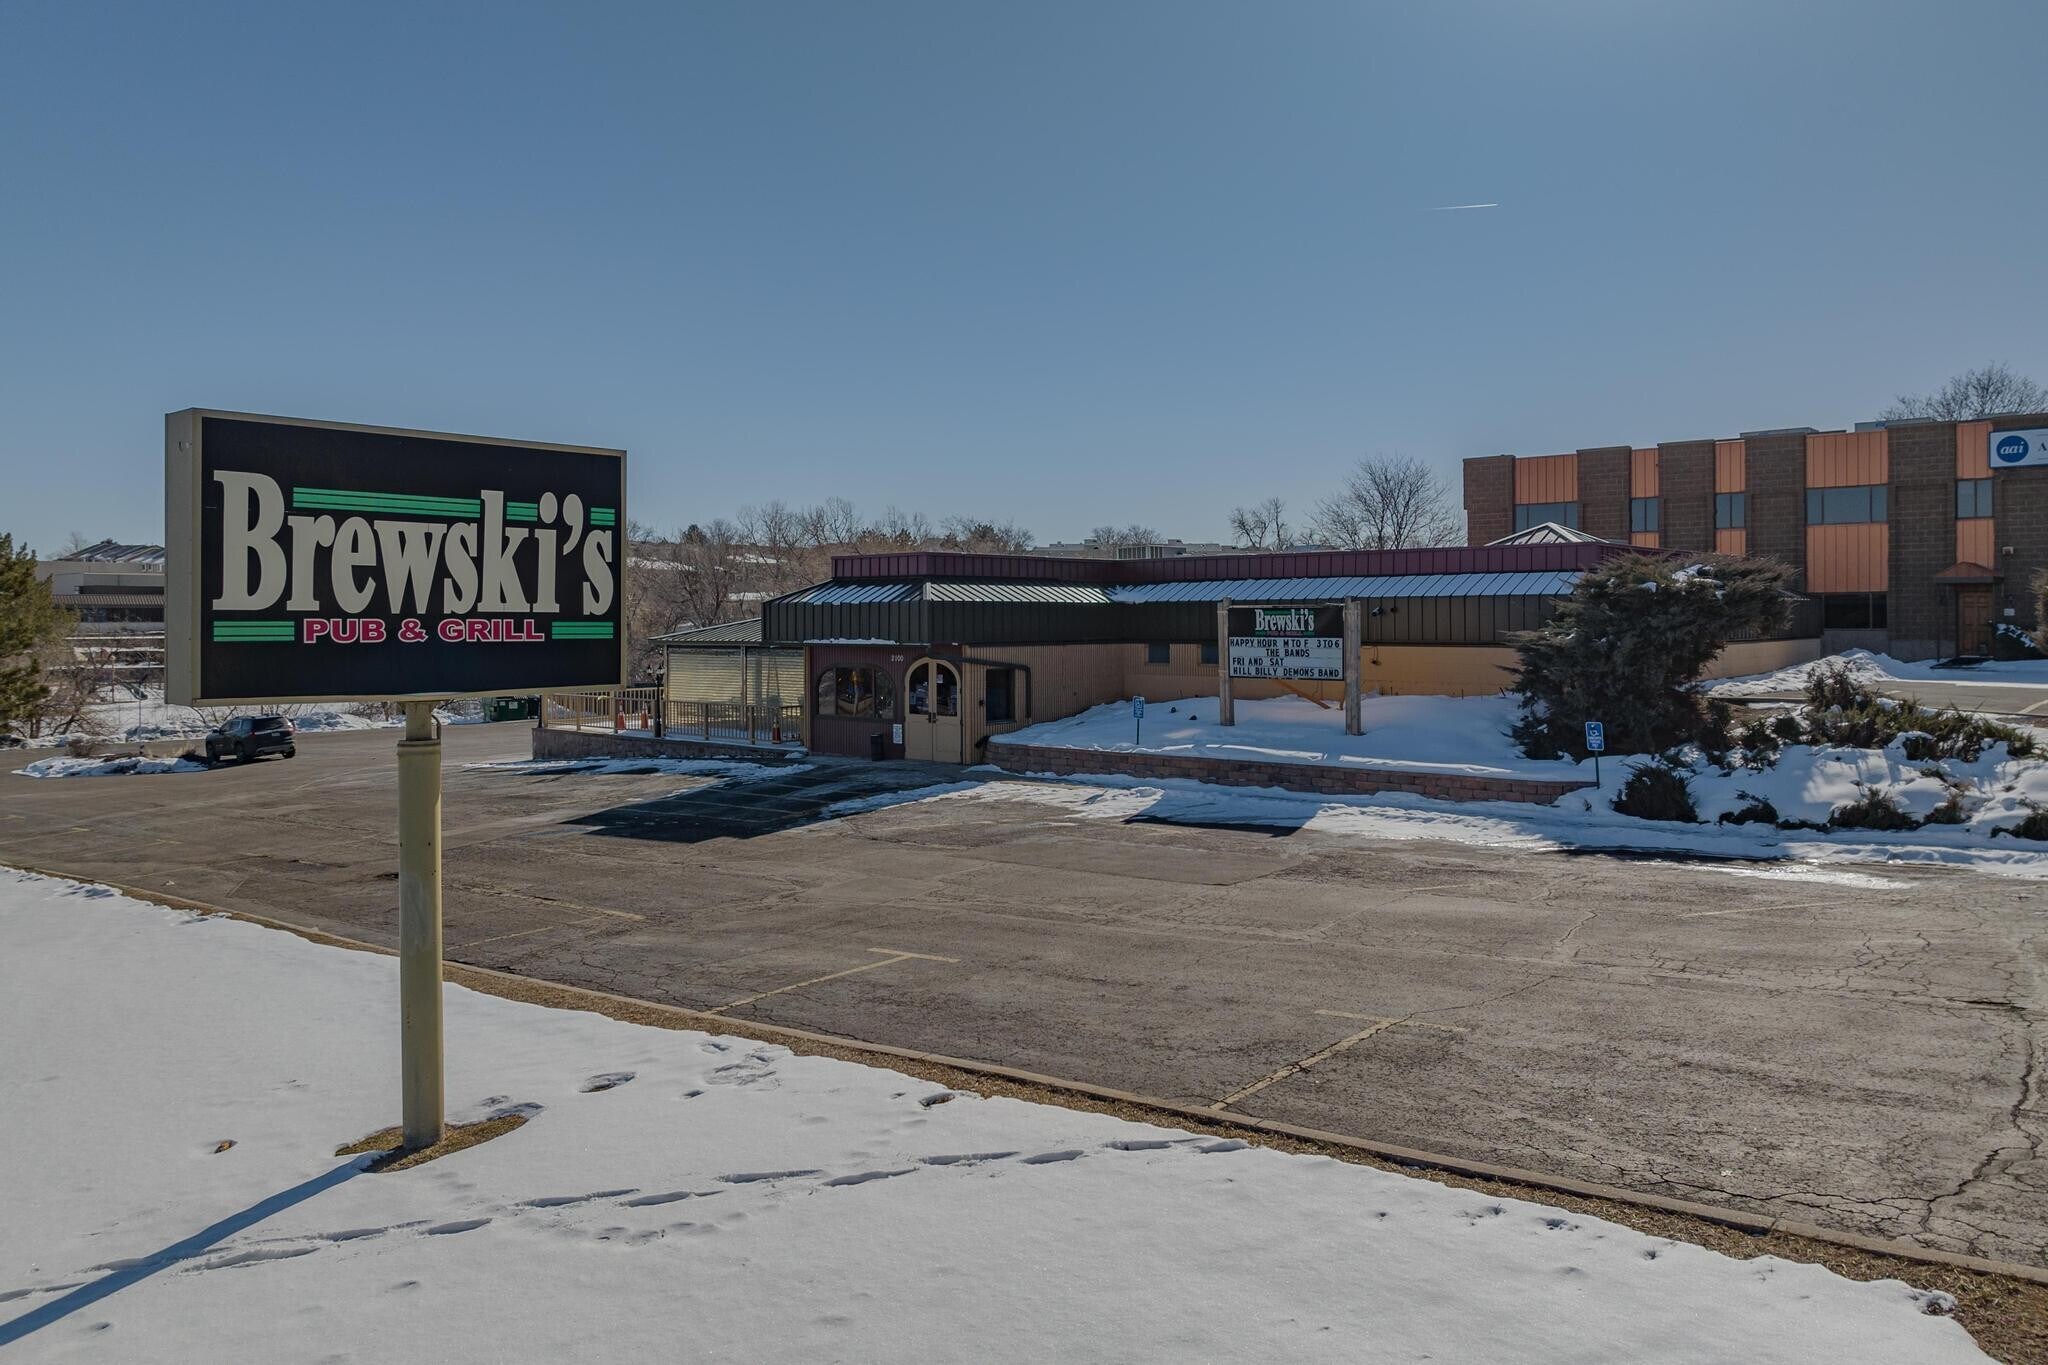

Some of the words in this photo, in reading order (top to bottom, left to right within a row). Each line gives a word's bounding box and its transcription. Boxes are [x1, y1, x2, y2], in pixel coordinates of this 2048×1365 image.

[2000, 441, 2025, 455] aai
[212, 470, 615, 616] Brewski's
[1254, 608, 1315, 632] Brewski's
[303, 618, 387, 644] PUB
[398, 618, 429, 643] &
[437, 618, 545, 644] GRILL
[1230, 638, 1254, 648] HAPPY
[1257, 638, 1278, 648] HOUR
[1265, 648, 1280, 657] THE
[1284, 648, 1310, 658] BANDS
[1232, 657, 1245, 666] FRI
[1248, 657, 1264, 667] AND
[1269, 658, 1284, 667] SAT
[1233, 666, 1252, 676] HILL
[1255, 667, 1278, 676] BILLY
[1283, 667, 1315, 678] DEMONS
[1318, 668, 1340, 678] BAND
